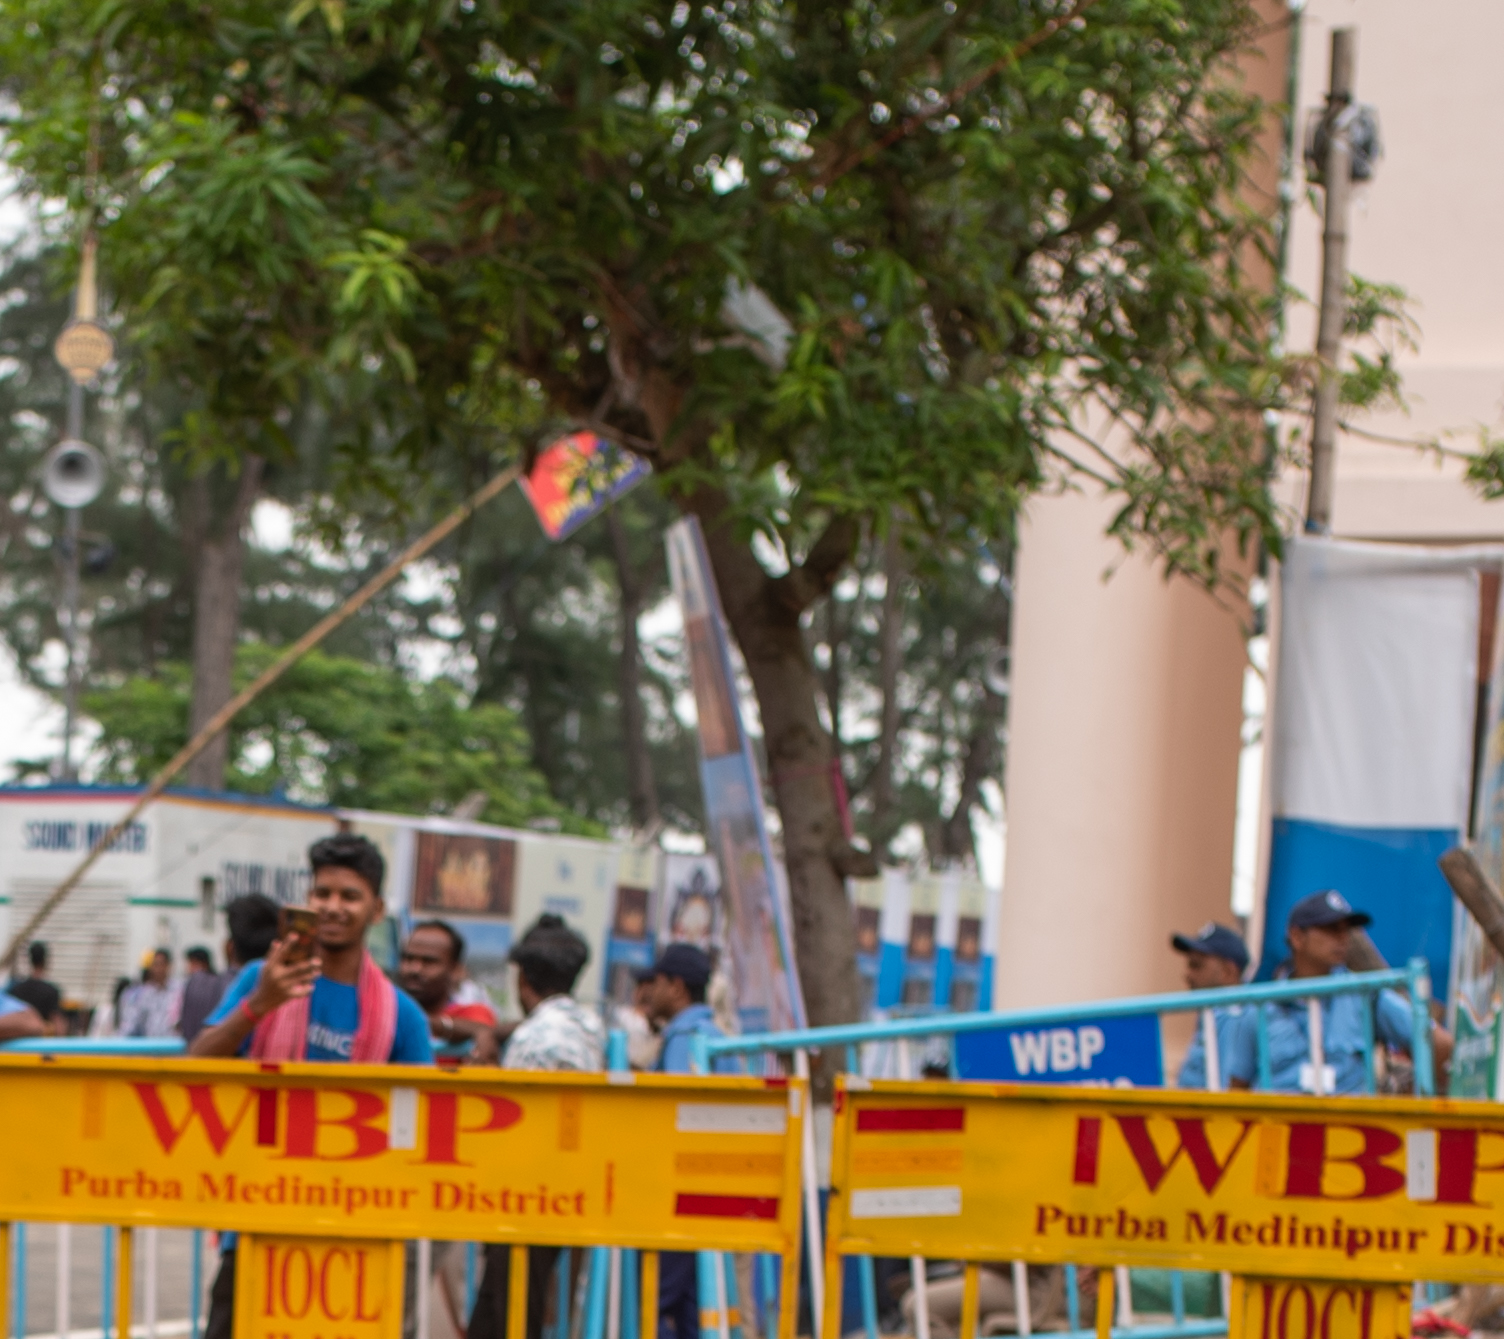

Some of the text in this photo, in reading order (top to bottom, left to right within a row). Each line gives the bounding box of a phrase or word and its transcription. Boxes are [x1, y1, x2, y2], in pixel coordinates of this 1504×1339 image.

[1009, 1025, 1105, 1075] WBP
[128, 1081, 524, 1168] WBP
[59, 1166, 587, 1218] Purba Medinipur District
[1033, 1203, 1169, 1244] Purba
[1184, 1210, 1427, 1260] Medinipur
[260, 1243, 383, 1323] IOCL
